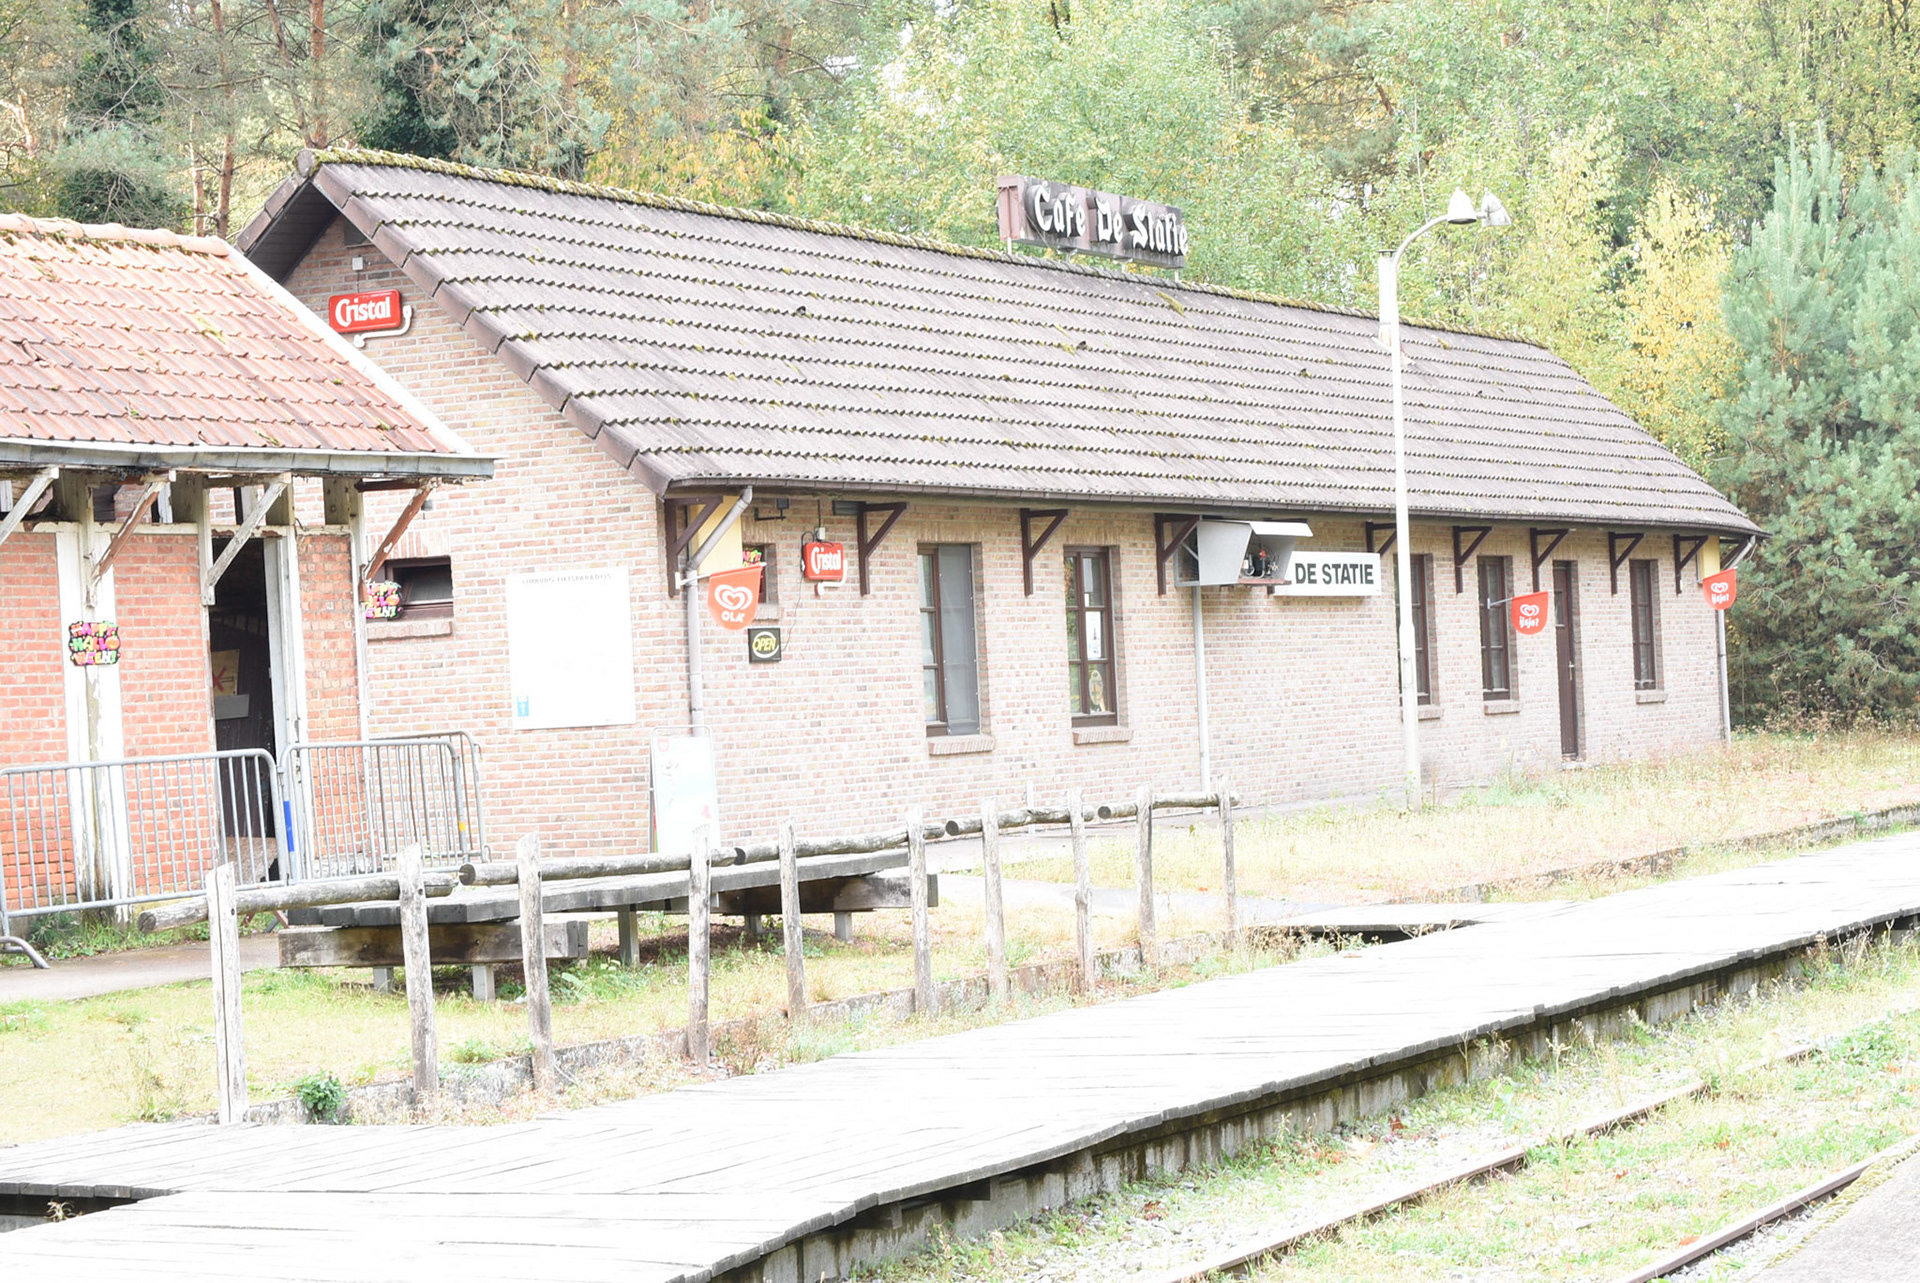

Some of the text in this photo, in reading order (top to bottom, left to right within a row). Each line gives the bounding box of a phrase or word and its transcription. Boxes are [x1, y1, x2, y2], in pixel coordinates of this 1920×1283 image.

[1095, 197, 1124, 243] De
[1130, 204, 1188, 256] Statie
[335, 296, 391, 327] Cristal
[811, 546, 842, 575] Cristal
[1295, 563, 1374, 585] DE STATIE
[752, 637, 776, 651] OPEN
